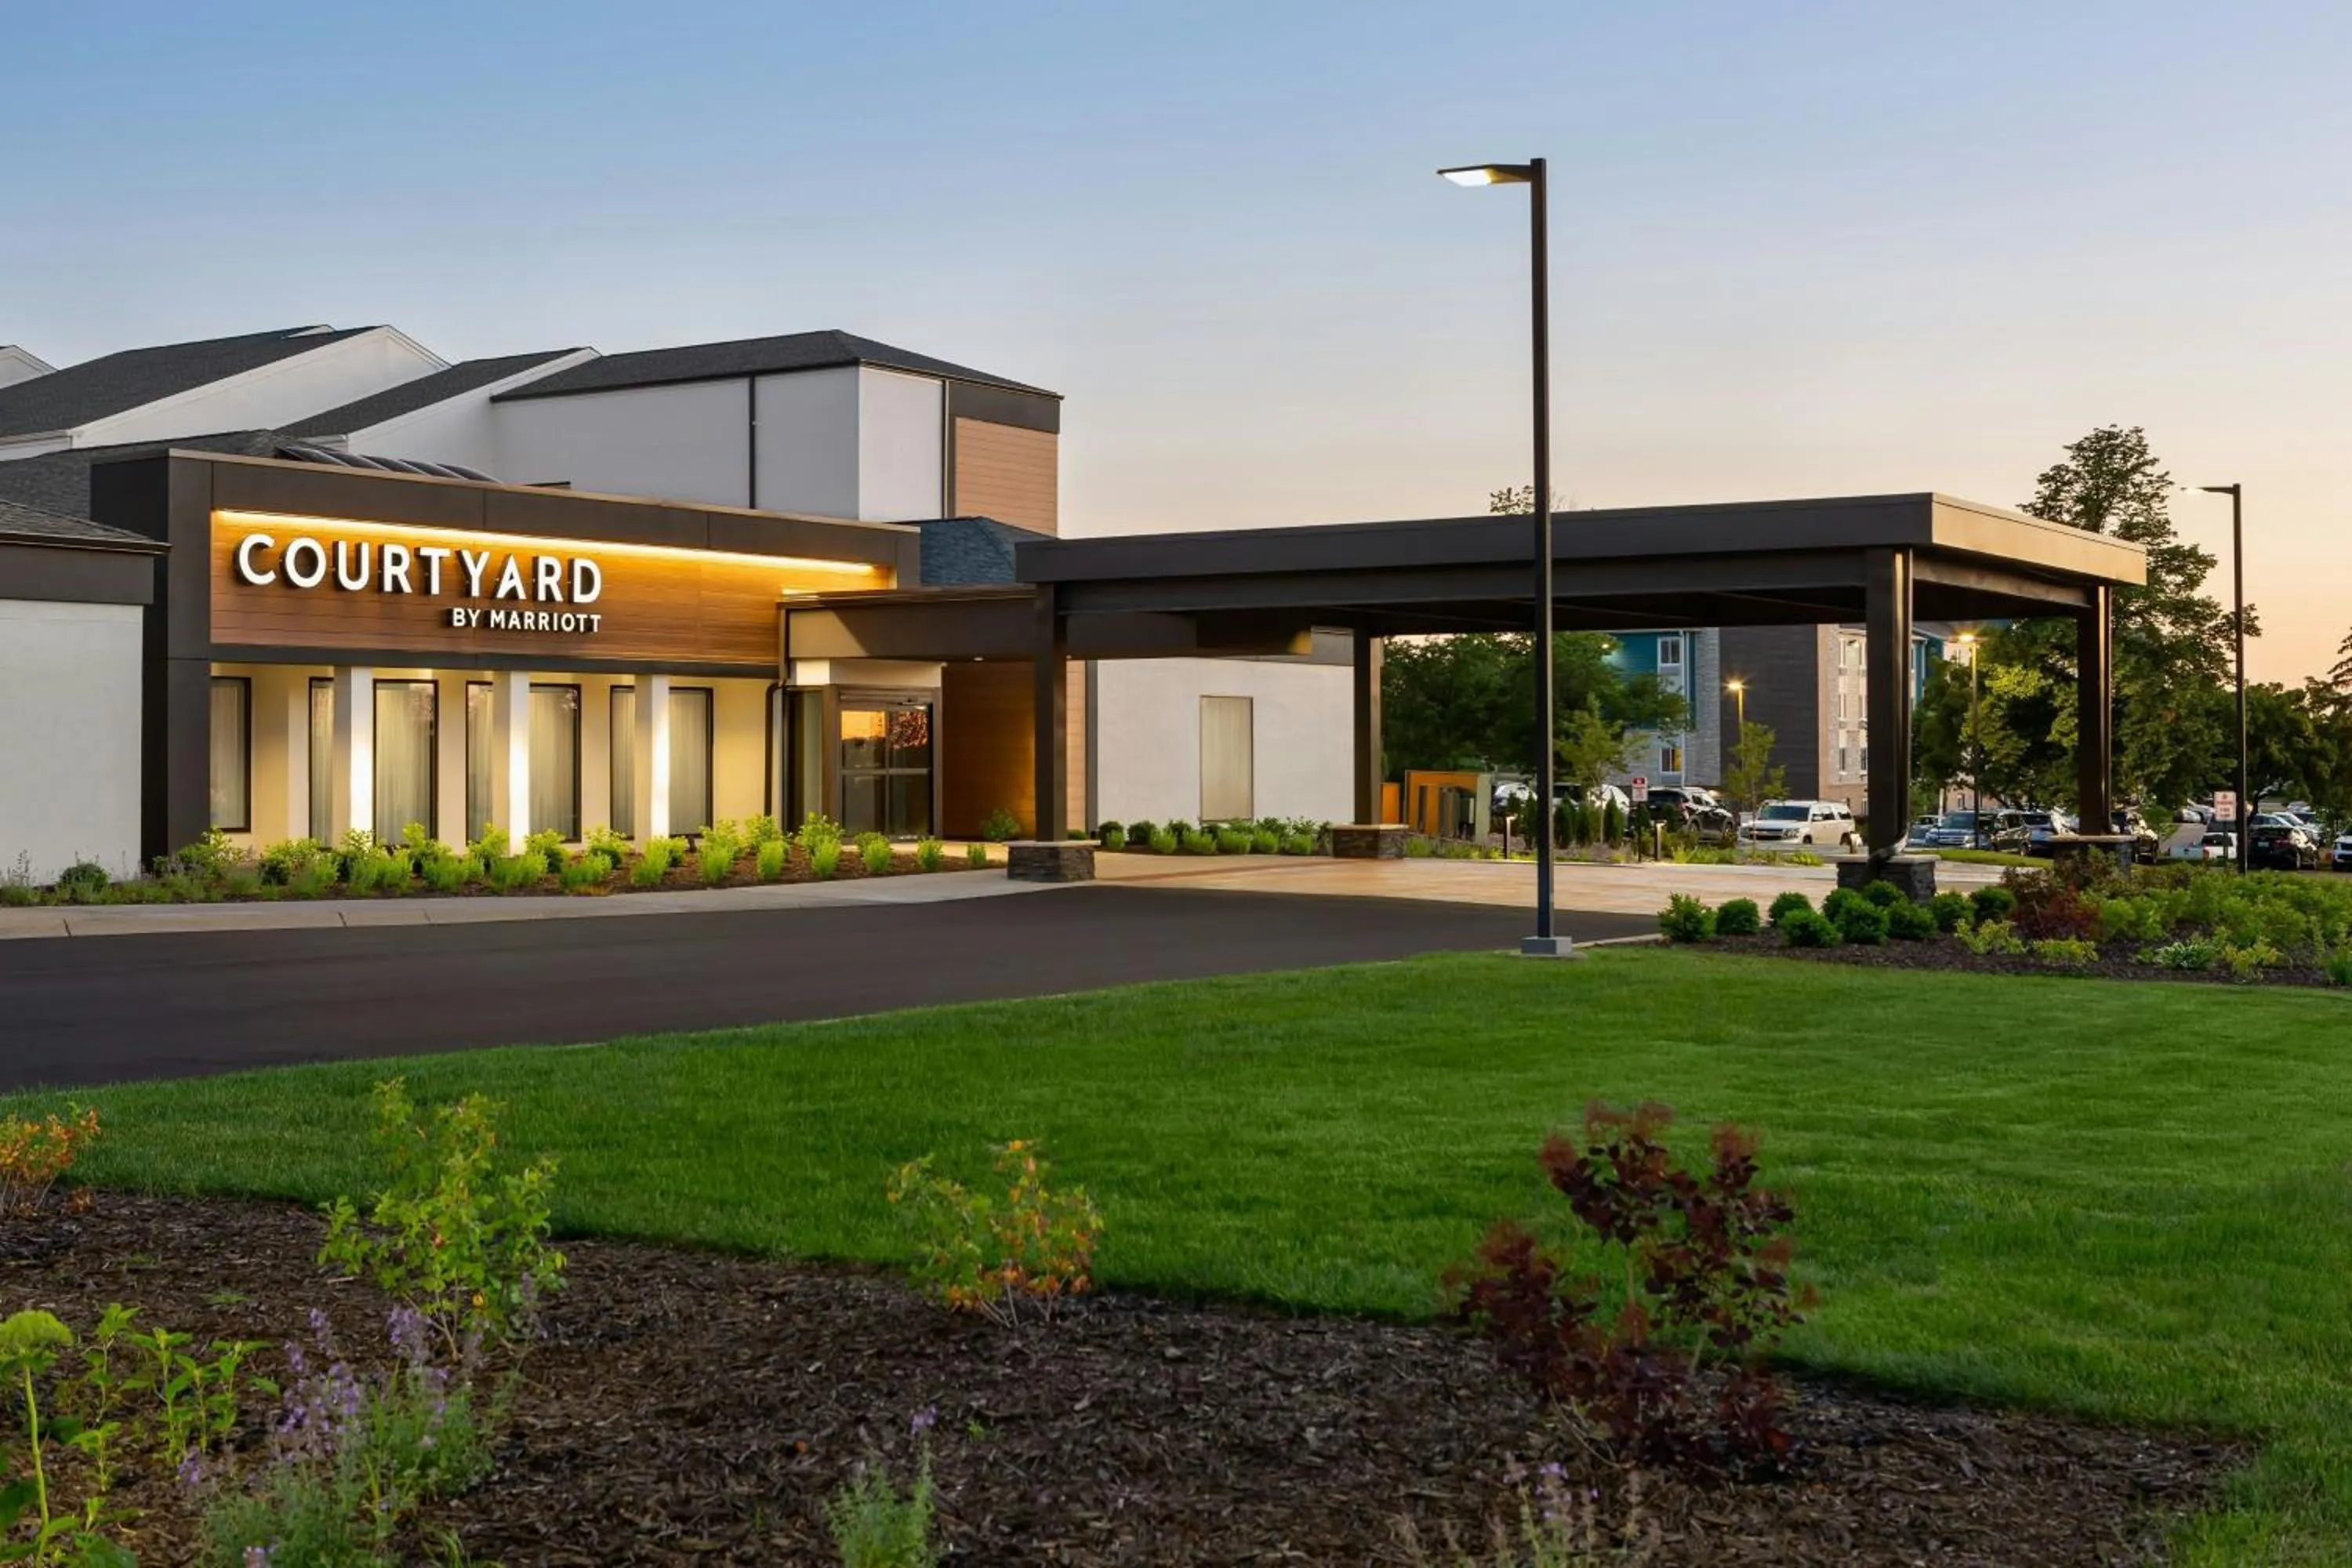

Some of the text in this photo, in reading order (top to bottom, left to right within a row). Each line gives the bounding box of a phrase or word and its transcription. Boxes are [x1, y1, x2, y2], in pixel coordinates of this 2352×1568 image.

[238, 533, 602, 604] COURTYARD
[452, 608, 602, 633] BY MARRIOTT
